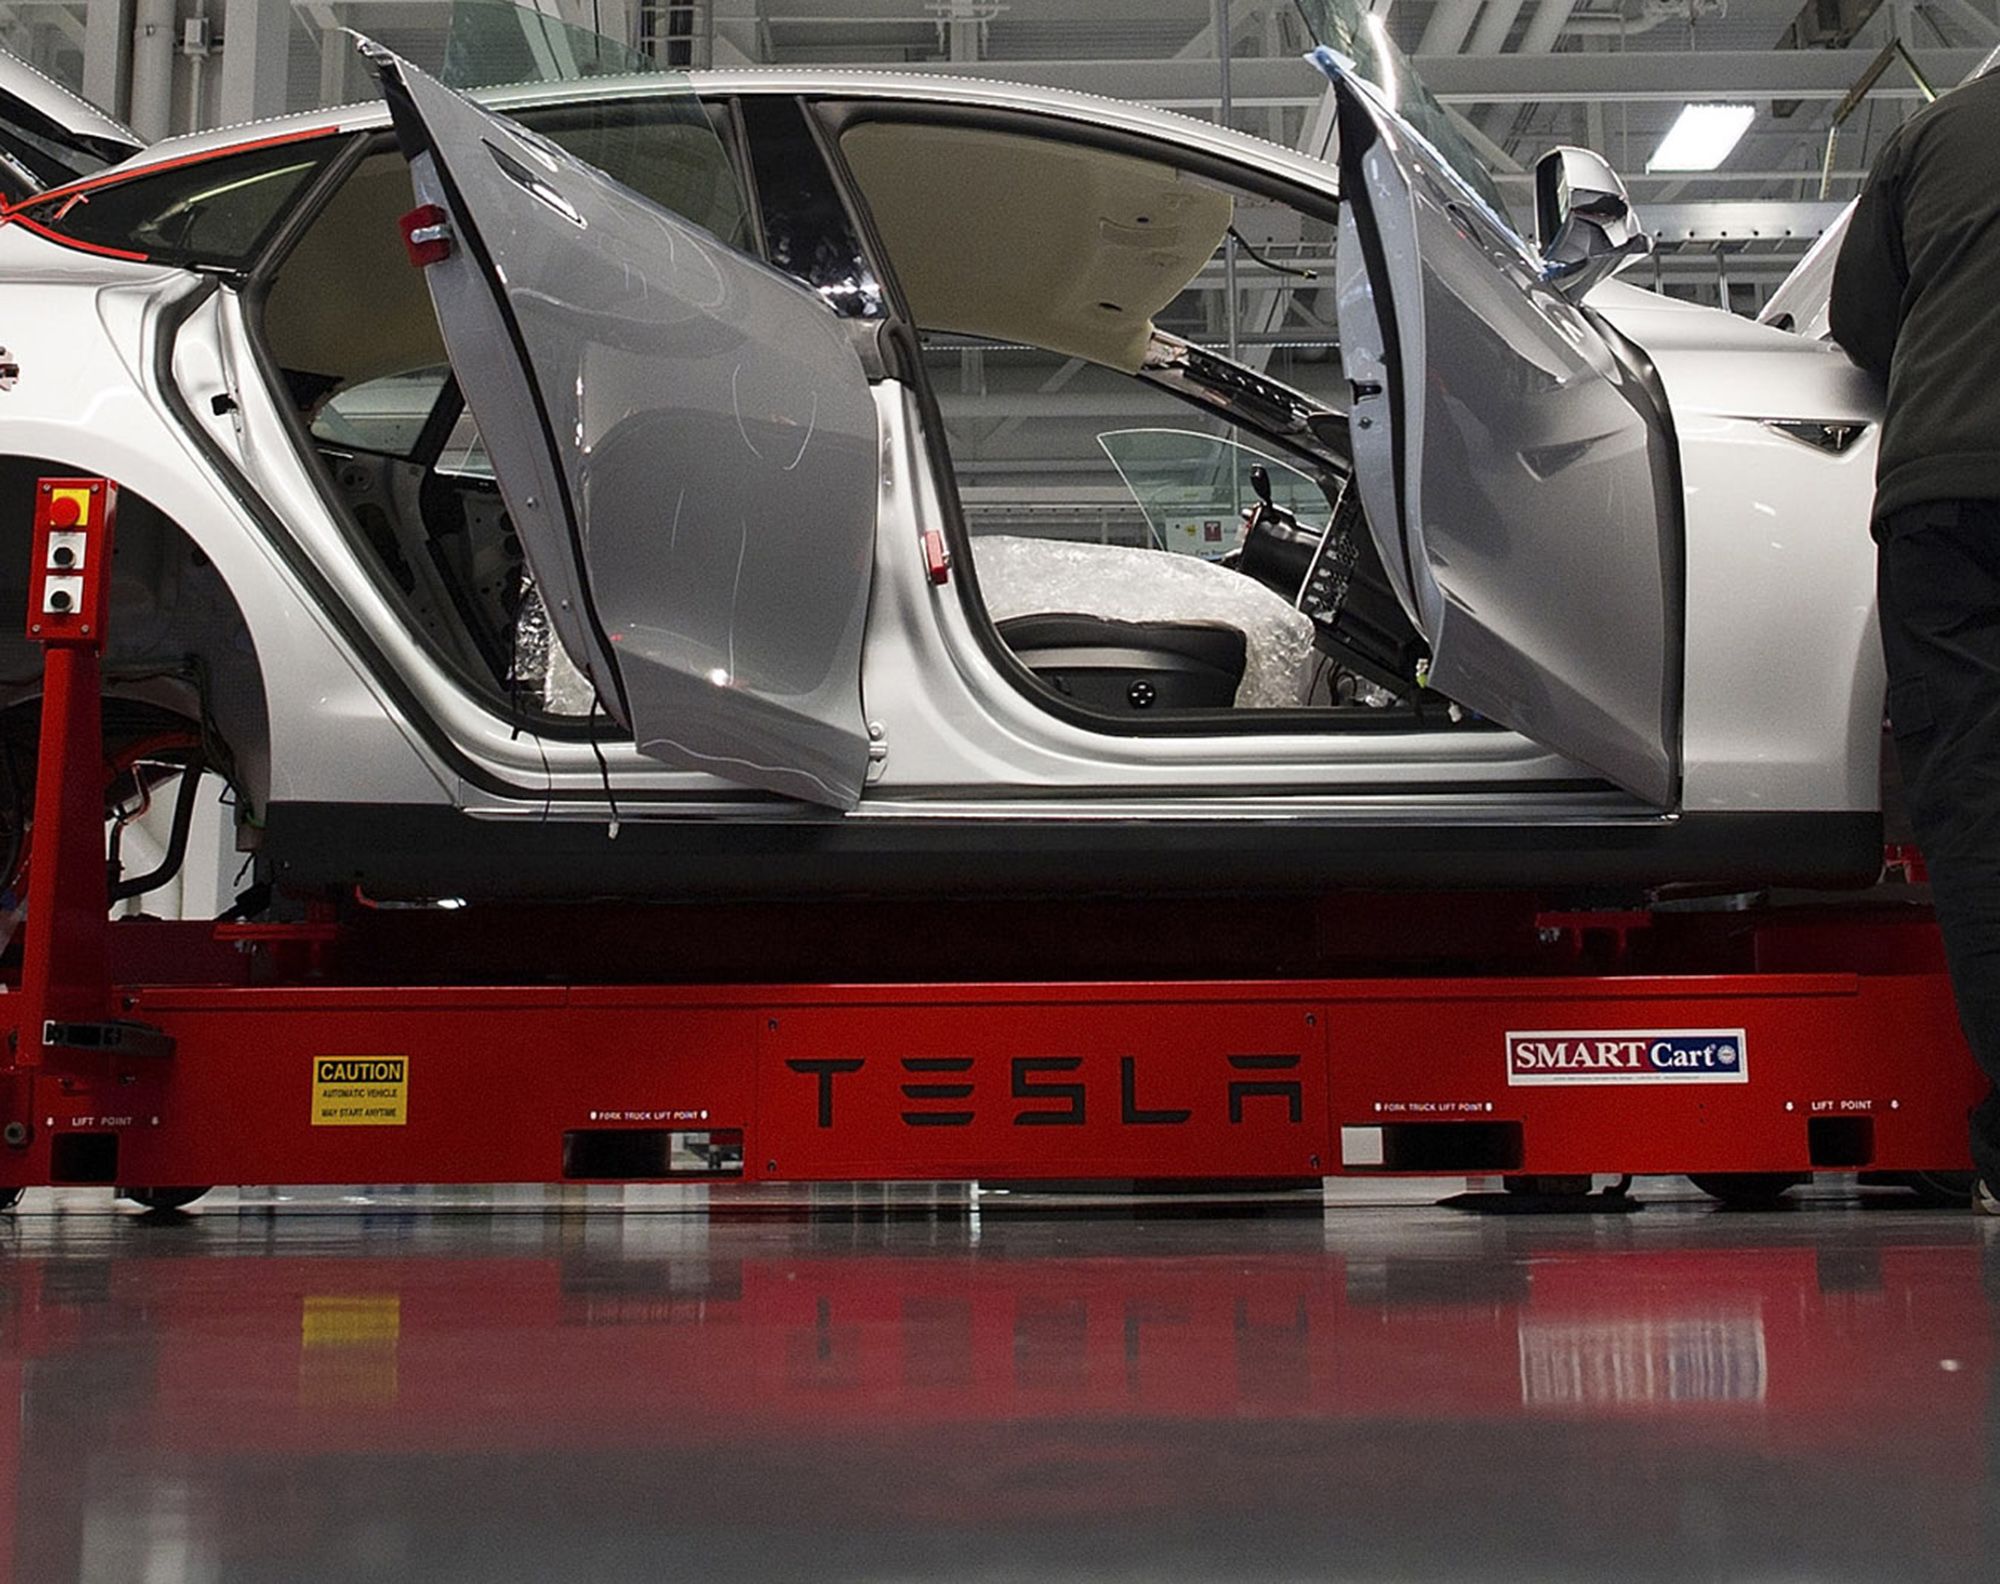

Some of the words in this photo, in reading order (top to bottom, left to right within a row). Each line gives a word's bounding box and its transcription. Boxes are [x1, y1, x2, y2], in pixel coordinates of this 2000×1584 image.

[1516, 1042, 1646, 1068] SMART
[320, 1063, 401, 1080] CAUTION
[322, 1088, 365, 1098] AUTOMATIC
[367, 1088, 398, 1098] VEHICLE
[785, 1054, 1301, 1128] TESLA
[1383, 1103, 1406, 1112] FORK
[1409, 1103, 1436, 1112] TRUCK
[1438, 1103, 1456, 1111] LIFT
[1458, 1102, 1483, 1111] POINT
[1811, 1101, 1834, 1111] LIFT
[1840, 1100, 1873, 1110] POINT
[321, 1108, 337, 1117] MAY
[339, 1108, 363, 1117] START
[364, 1107, 397, 1117] ANYTIME
[599, 1111, 621, 1120] FORK
[624, 1111, 651, 1120] TRUCK
[653, 1111, 671, 1120] LIFT
[674, 1111, 698, 1119] POINT
[72, 1116, 94, 1126] LIFT
[101, 1116, 133, 1126] POINT
